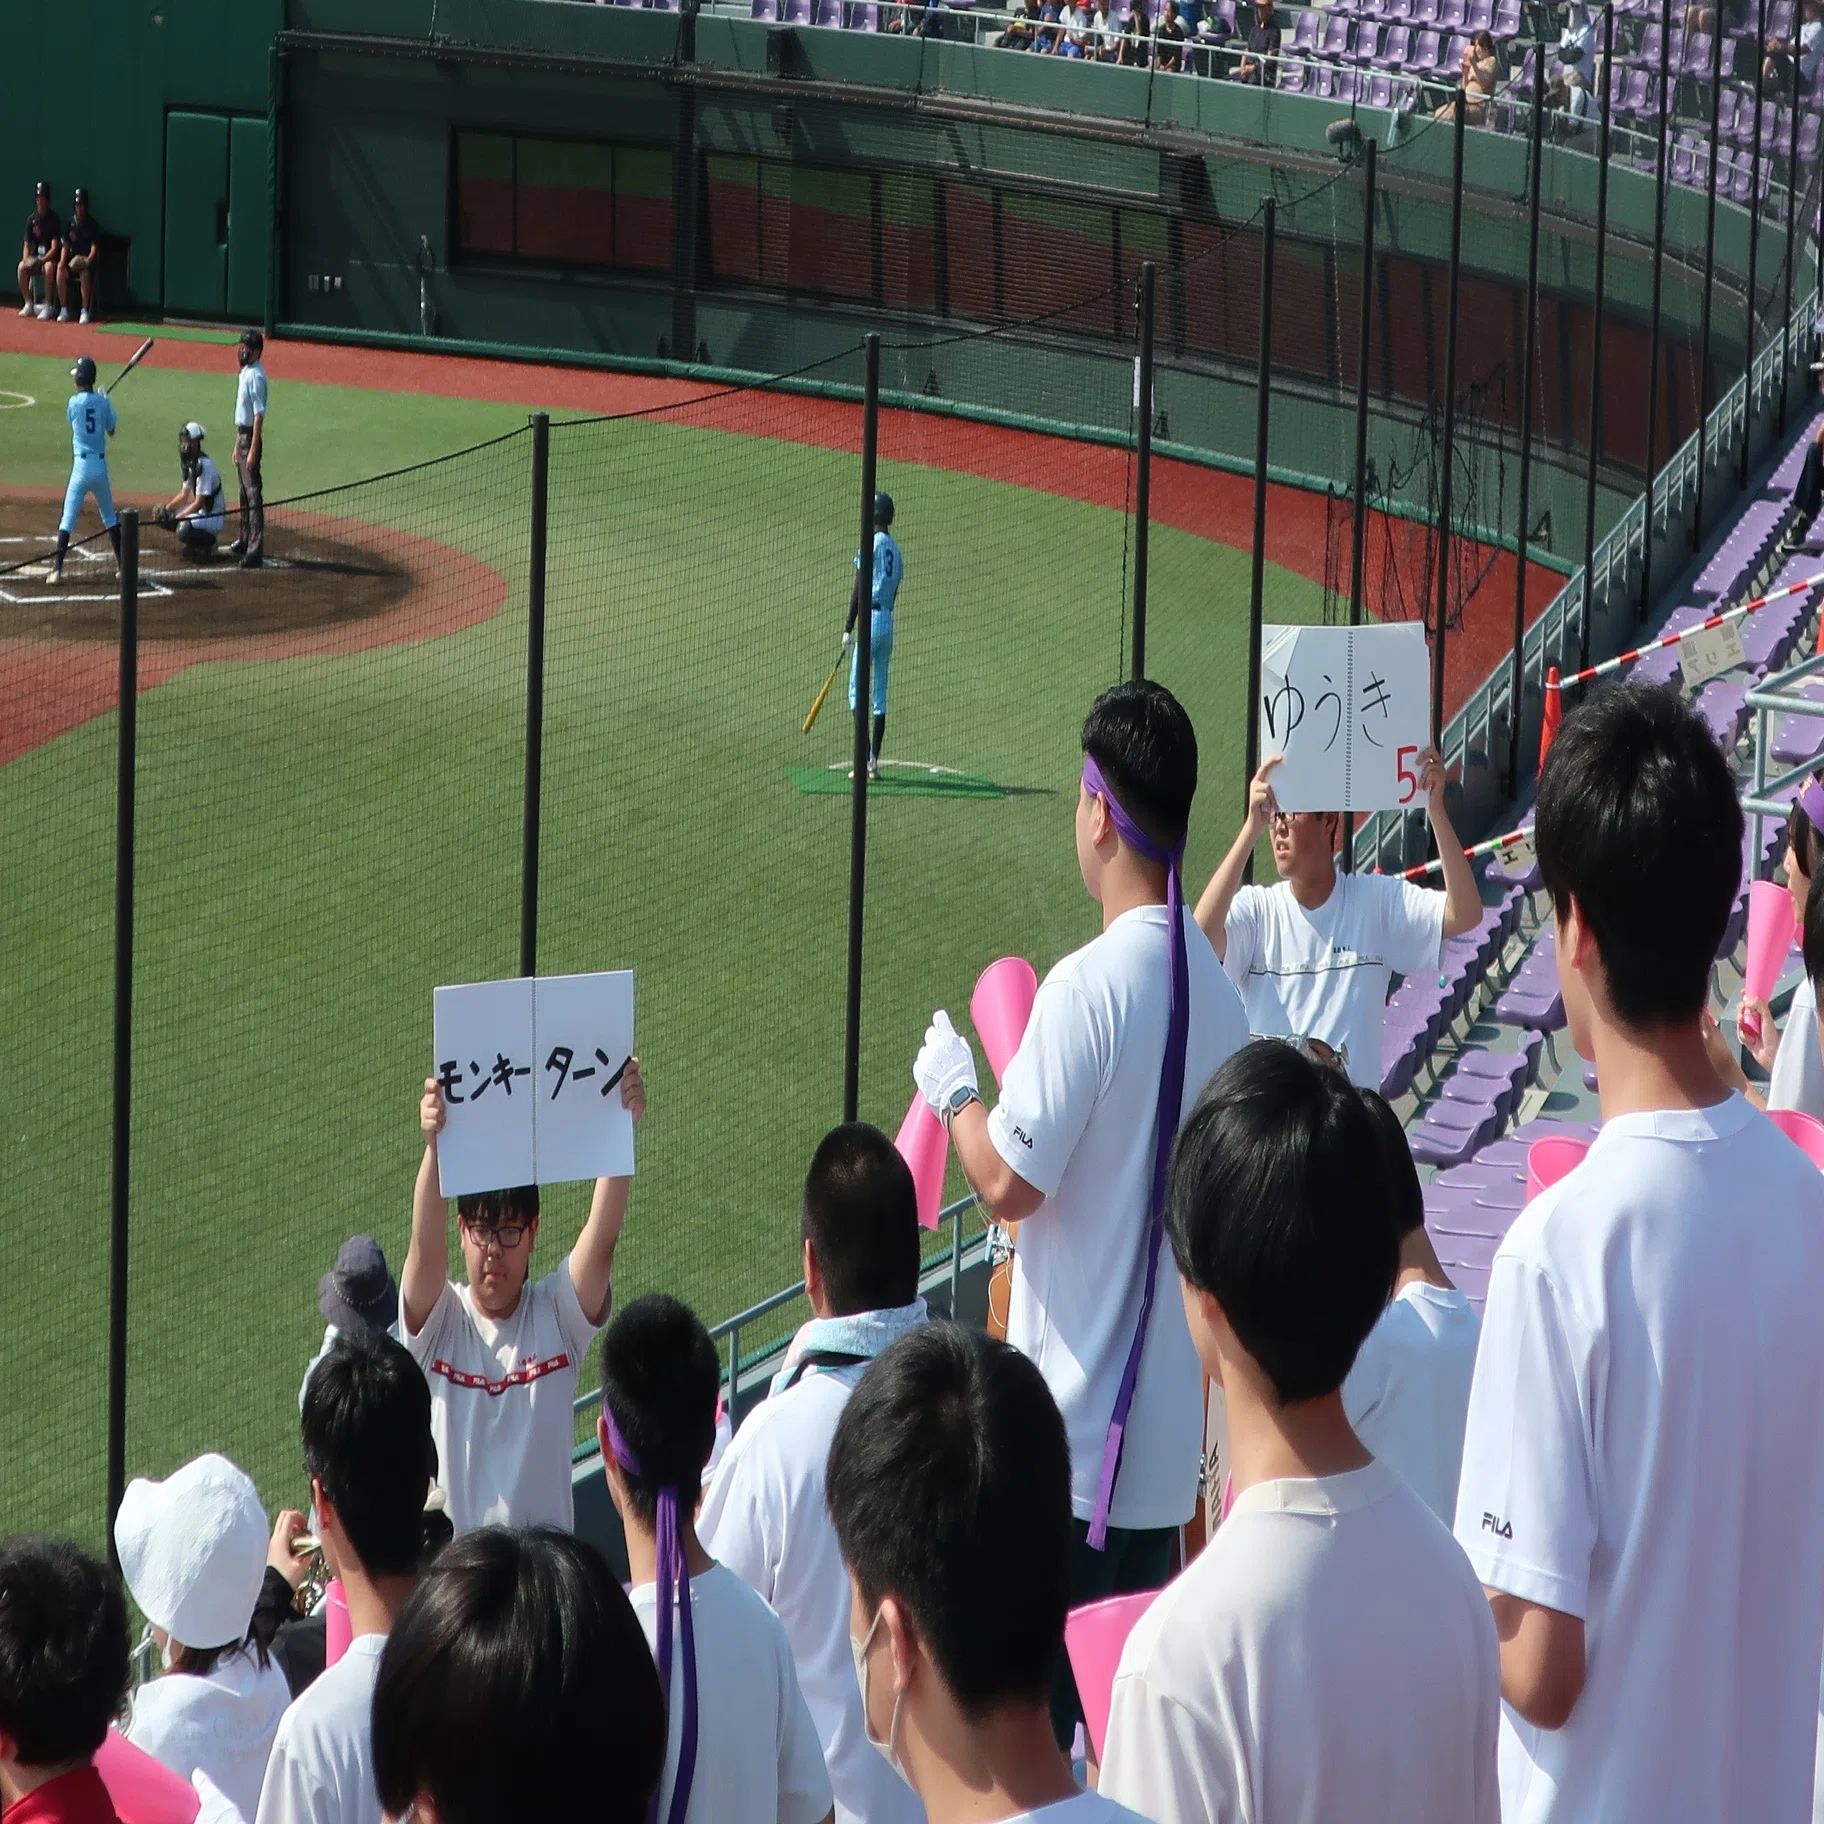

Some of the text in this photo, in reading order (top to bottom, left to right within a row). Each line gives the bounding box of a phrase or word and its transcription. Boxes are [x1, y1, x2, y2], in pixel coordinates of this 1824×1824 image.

[85, 408, 96, 434] 5
[885, 549, 894, 577] 3
[1264, 671, 1391, 753] ゆうき
[1397, 745, 1418, 804] 5
[438, 1046, 632, 1105] モンキーターン
[1013, 1125, 1033, 1150] FILA
[1482, 1511, 1513, 1540] FILA
